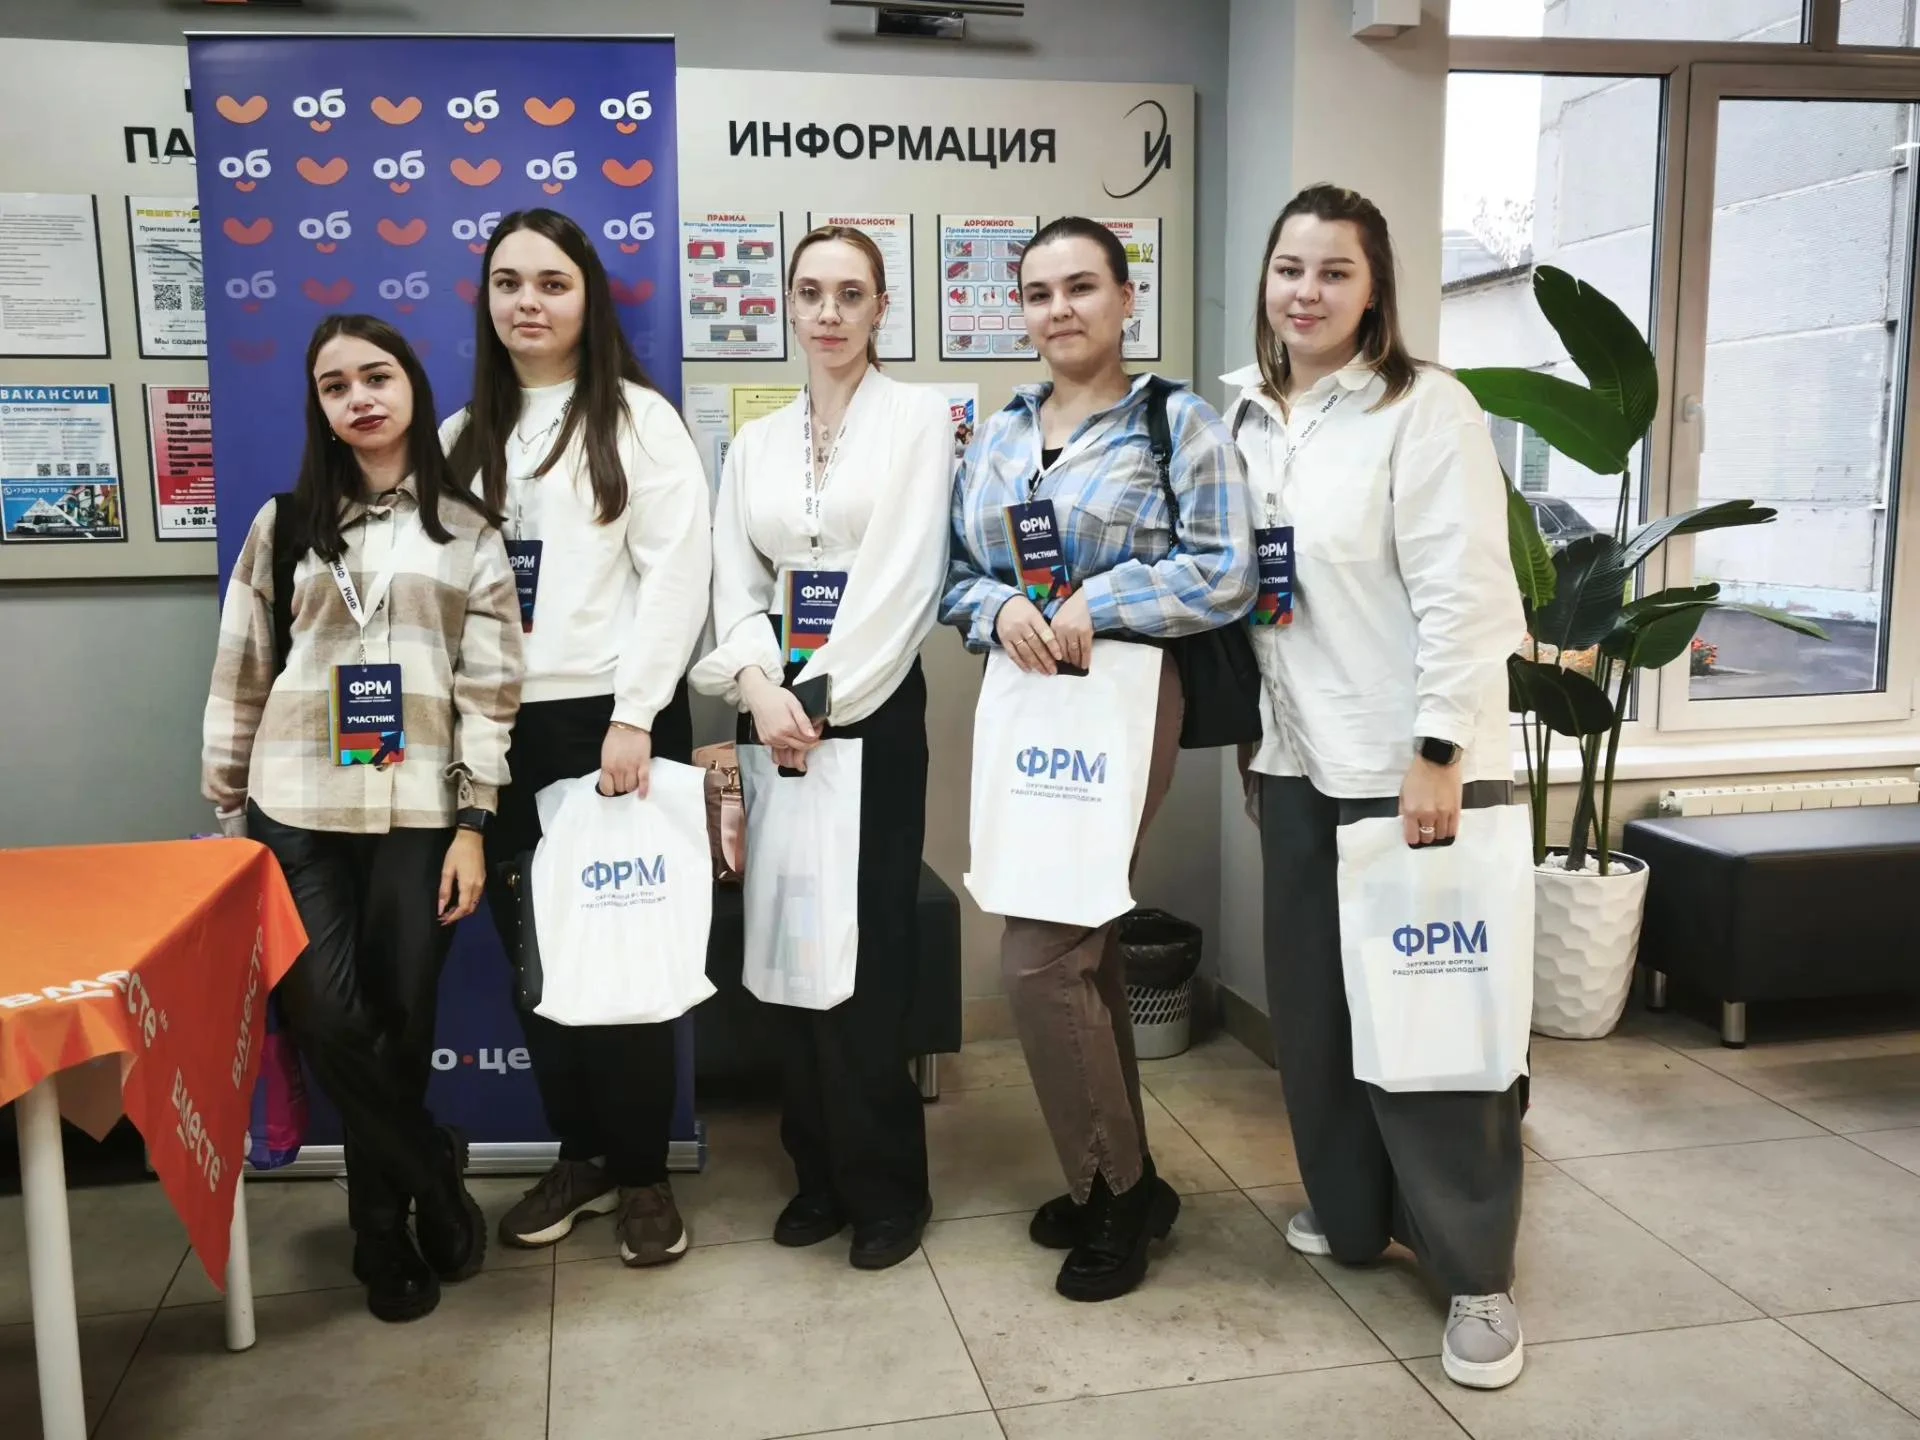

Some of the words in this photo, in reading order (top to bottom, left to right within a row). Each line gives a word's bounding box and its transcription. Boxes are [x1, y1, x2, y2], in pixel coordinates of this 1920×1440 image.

[293, 88, 346, 118] об
[447, 89, 500, 119] об
[600, 91, 652, 120] об
[729, 120, 1056, 169] ИНФОРМАЦИЯ
[219, 149, 271, 178] об
[373, 150, 425, 179] об
[526, 151, 577, 180] об
[299, 210, 351, 240] об
[603, 212, 655, 240] об
[707, 214, 746, 222] ПРАВИЛА
[828, 217, 896, 226] БЕЗОПАСНОСТИ
[964, 219, 1014, 227] ДОРОЖНОГО
[225, 270, 277, 299] об
[378, 271, 430, 299] об
[1, 389, 99, 400] ВАКАНСИИ
[1019, 515, 1051, 533] ФРМ
[1024, 549, 1058, 561] УЧАСТНИК
[1258, 541, 1288, 558] ФРМ
[801, 585, 839, 600] ФРМ
[349, 680, 392, 695] ФРМ
[347, 714, 395, 724] УЧАСТНИК
[1016, 746, 1107, 784] ФРМ
[581, 854, 666, 891] ФРМ
[1392, 920, 1488, 957] ФРМ
